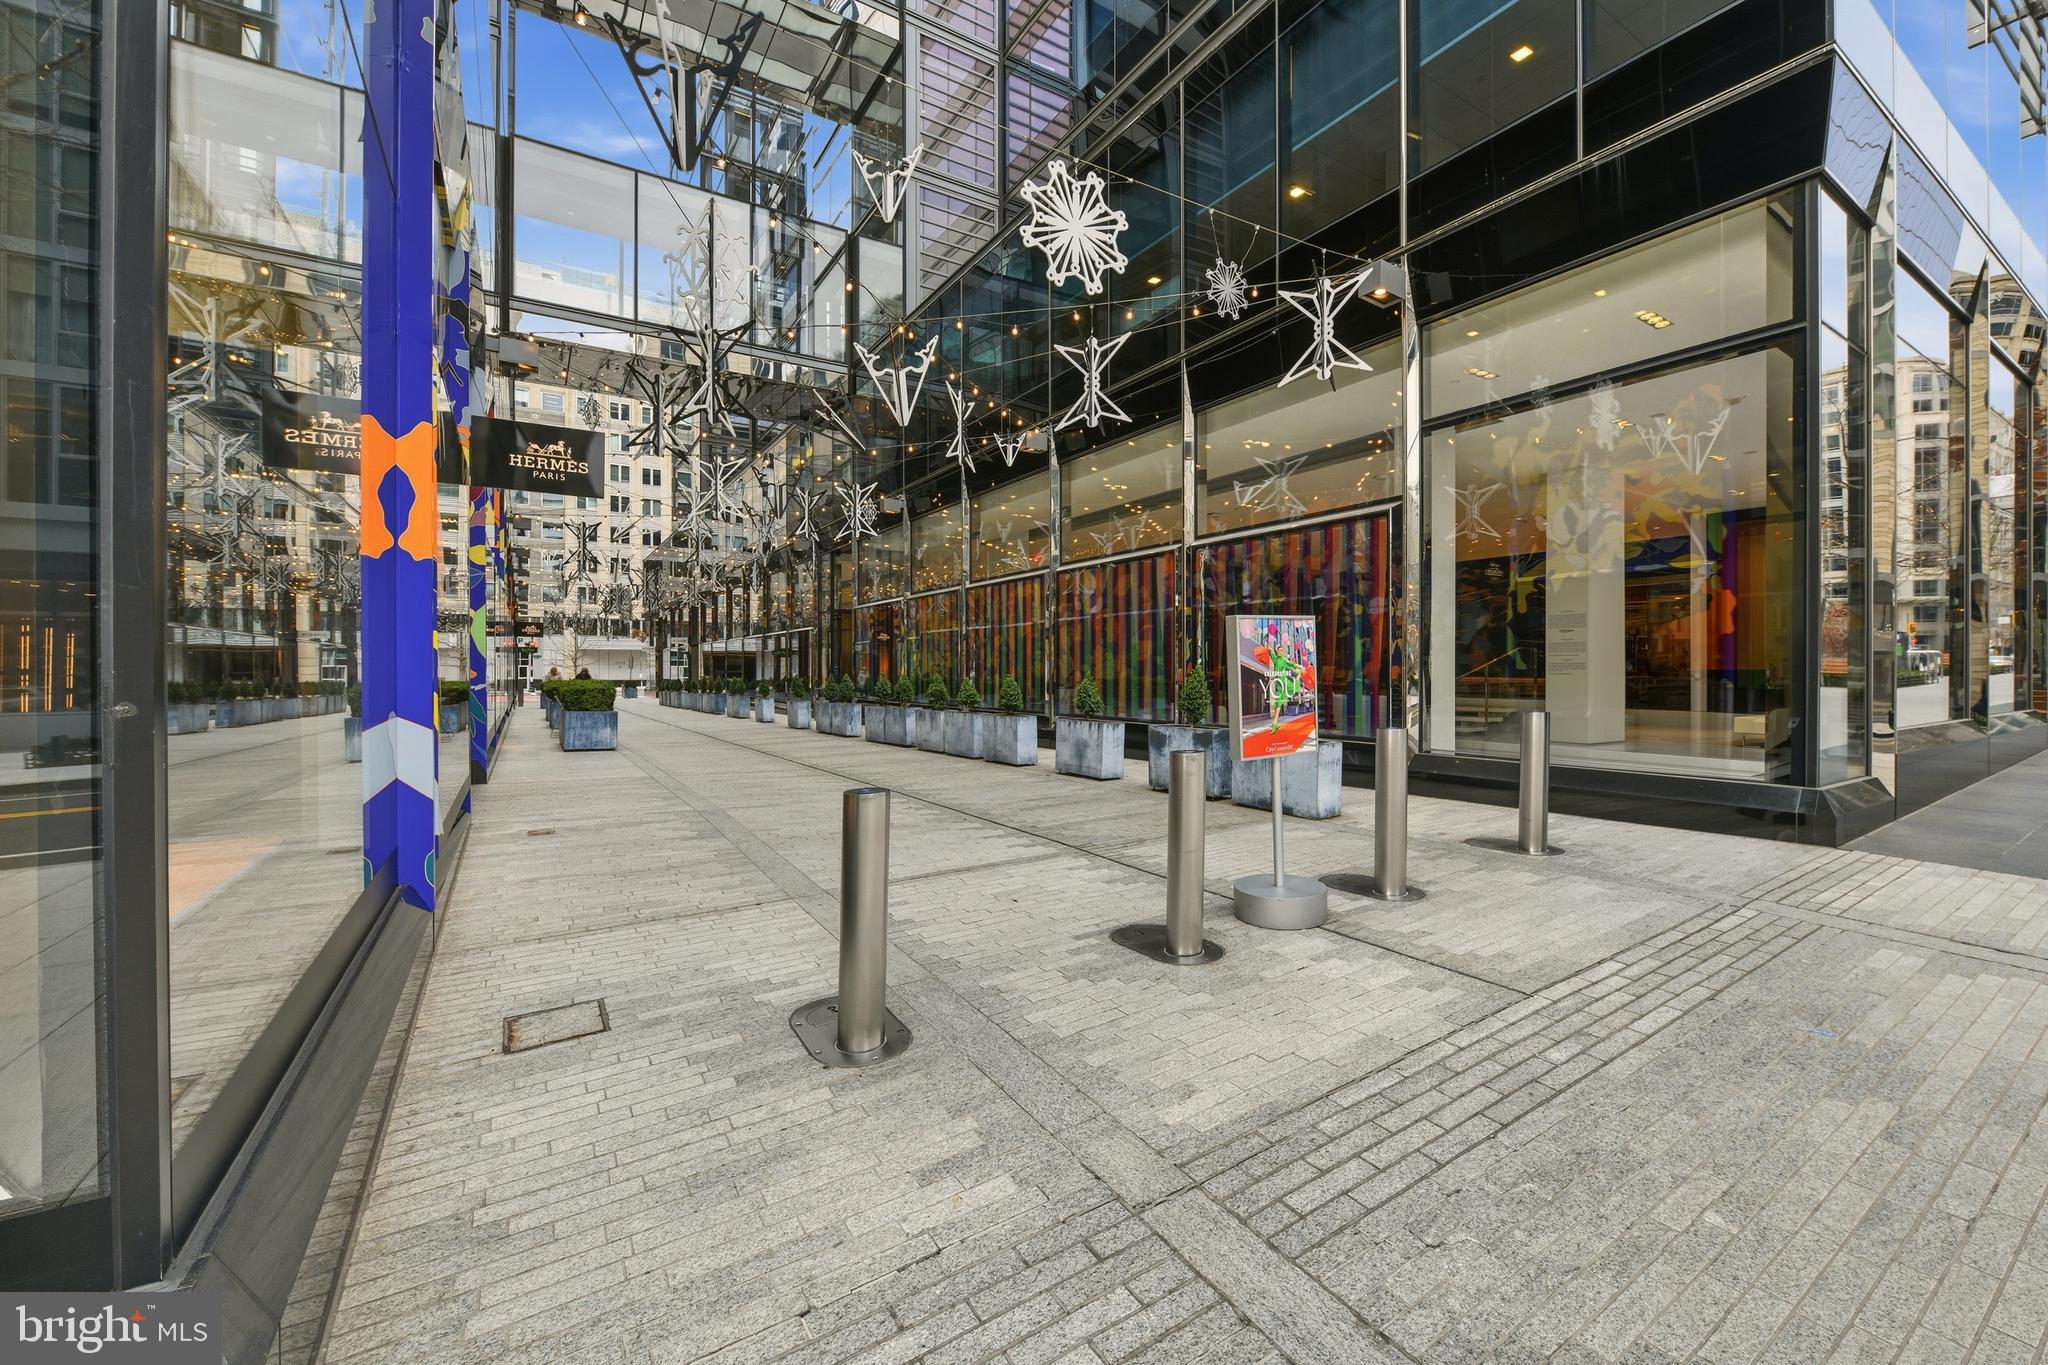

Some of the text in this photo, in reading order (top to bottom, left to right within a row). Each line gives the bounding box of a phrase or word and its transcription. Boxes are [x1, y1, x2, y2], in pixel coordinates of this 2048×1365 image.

[508, 453, 589, 474] HERMÈS
[532, 470, 566, 481] PARIS
[1258, 677, 1296, 699] YOU
